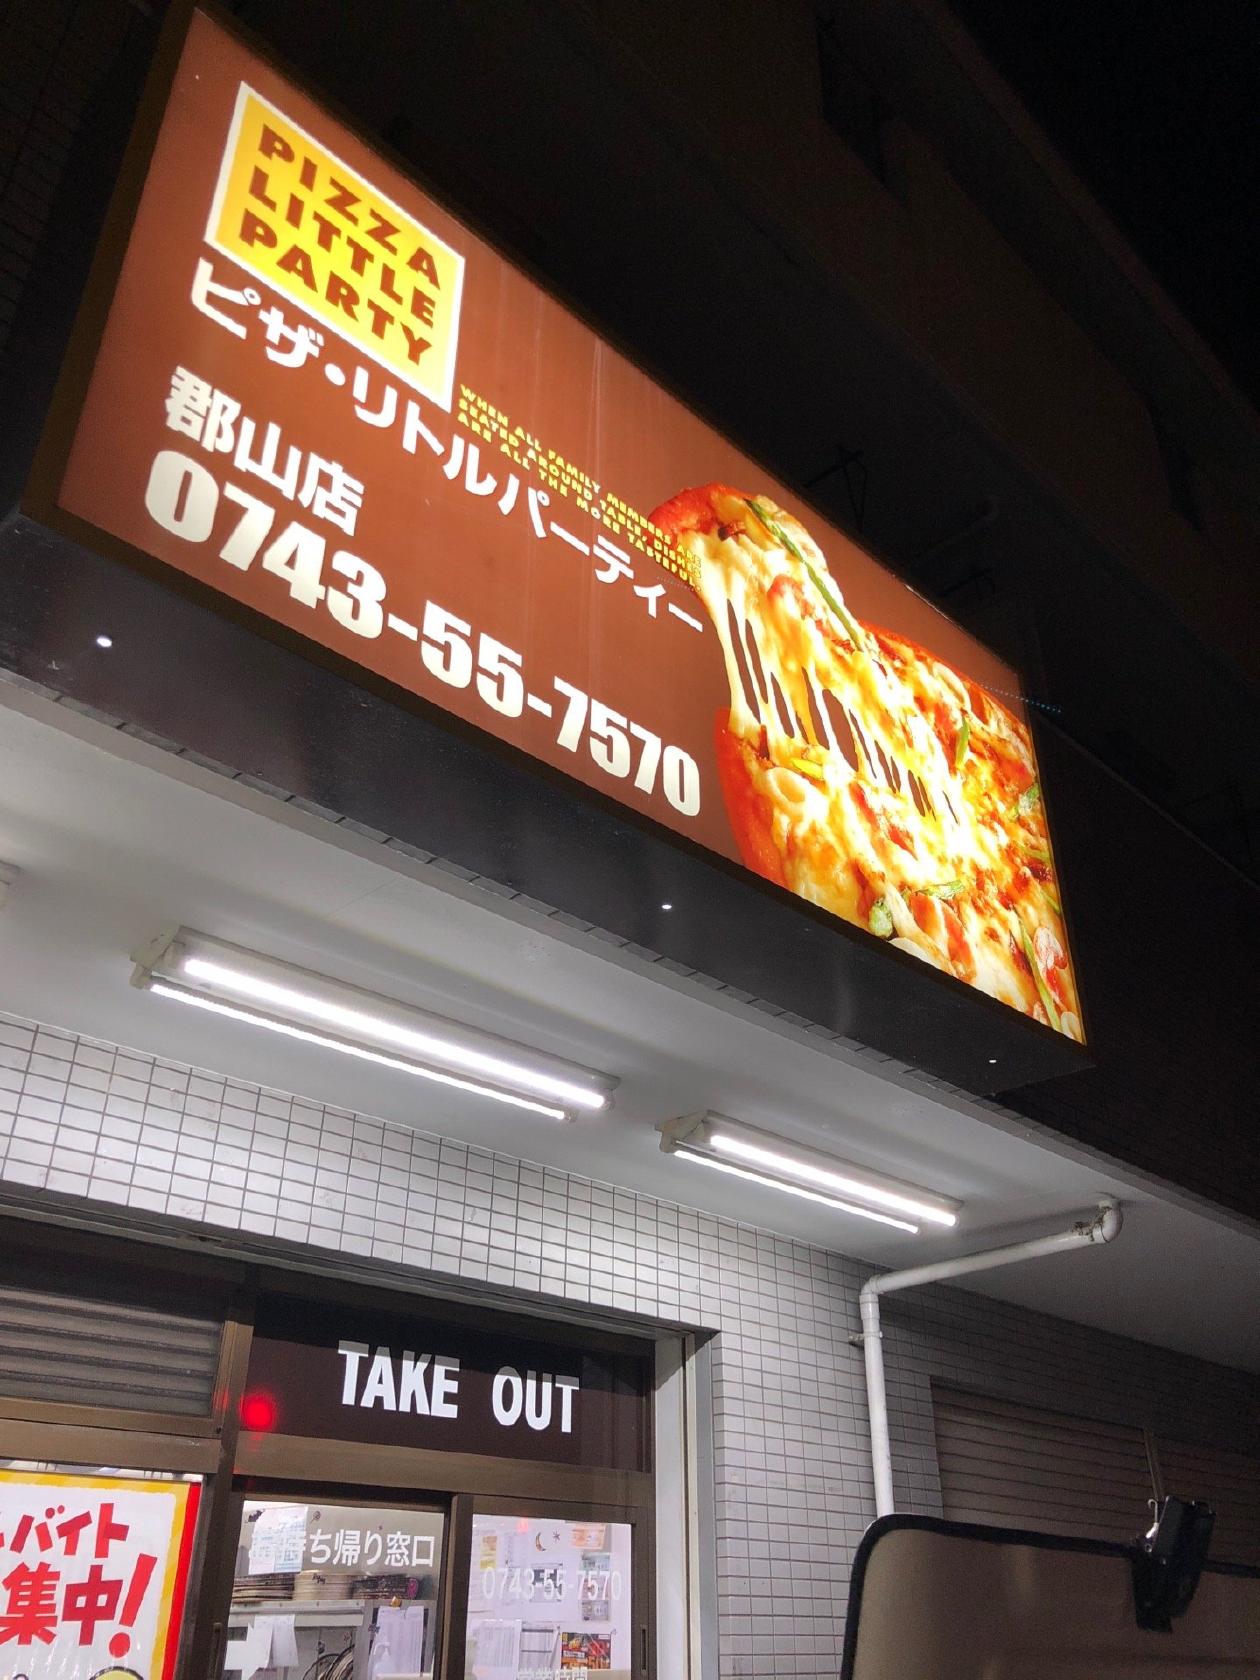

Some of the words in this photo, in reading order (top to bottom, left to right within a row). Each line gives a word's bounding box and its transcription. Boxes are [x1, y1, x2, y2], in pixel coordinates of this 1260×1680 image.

[239, 208, 432, 366] PARTY
[248, 165, 436, 328] LITTLE
[258, 124, 441, 290] PIZZA
[165, 365, 364, 537] 郡山店
[191, 257, 703, 633] ピザ・リトルパーティー
[457, 412, 492, 443] ARE
[500, 443, 531, 471] ALL
[538, 468, 568, 497] THE
[576, 496, 621, 535] MORE
[458, 398, 519, 447] SEATED
[527, 448, 593, 501] AROUND
[460, 384, 509, 427] WHEN
[514, 426, 542, 452] ALL
[548, 449, 601, 494] FAMILY
[606, 492, 672, 545] MEMBERS
[144, 450, 701, 816] 0743-55-7570
[338, 1340, 460, 1418] TAKE
[492, 1366, 580, 1433] OUT
[0, 1502, 130, 1559] バイト
